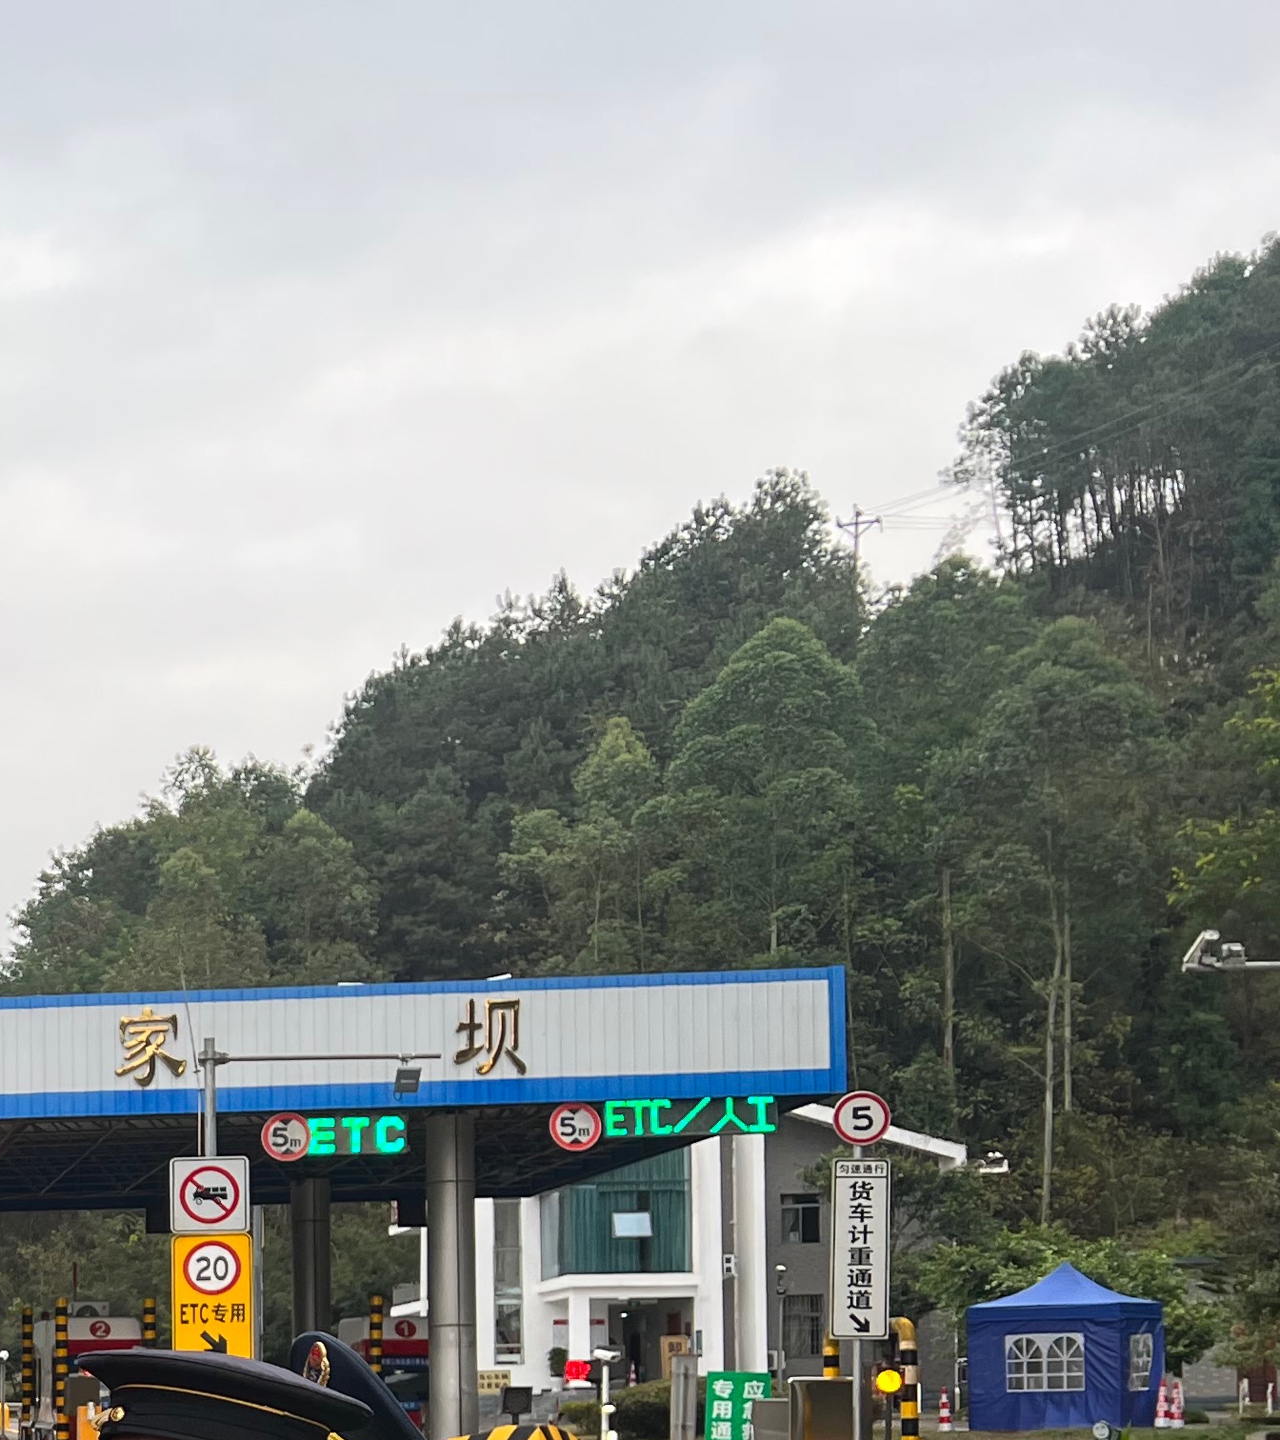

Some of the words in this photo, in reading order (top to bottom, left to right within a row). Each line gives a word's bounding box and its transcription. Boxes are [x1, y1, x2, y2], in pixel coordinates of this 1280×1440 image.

[852, 1106, 874, 1131] 5
[309, 1115, 406, 1155] ETC
[838, 1163, 885, 1175] 匀速通行
[847, 1181, 874, 1310] 货车计重通道
[195, 1256, 229, 1281] 20
[180, 1302, 246, 1324] ETC专用
[95, 1322, 107, 1337] 2
[399, 1322, 410, 1336] 1
